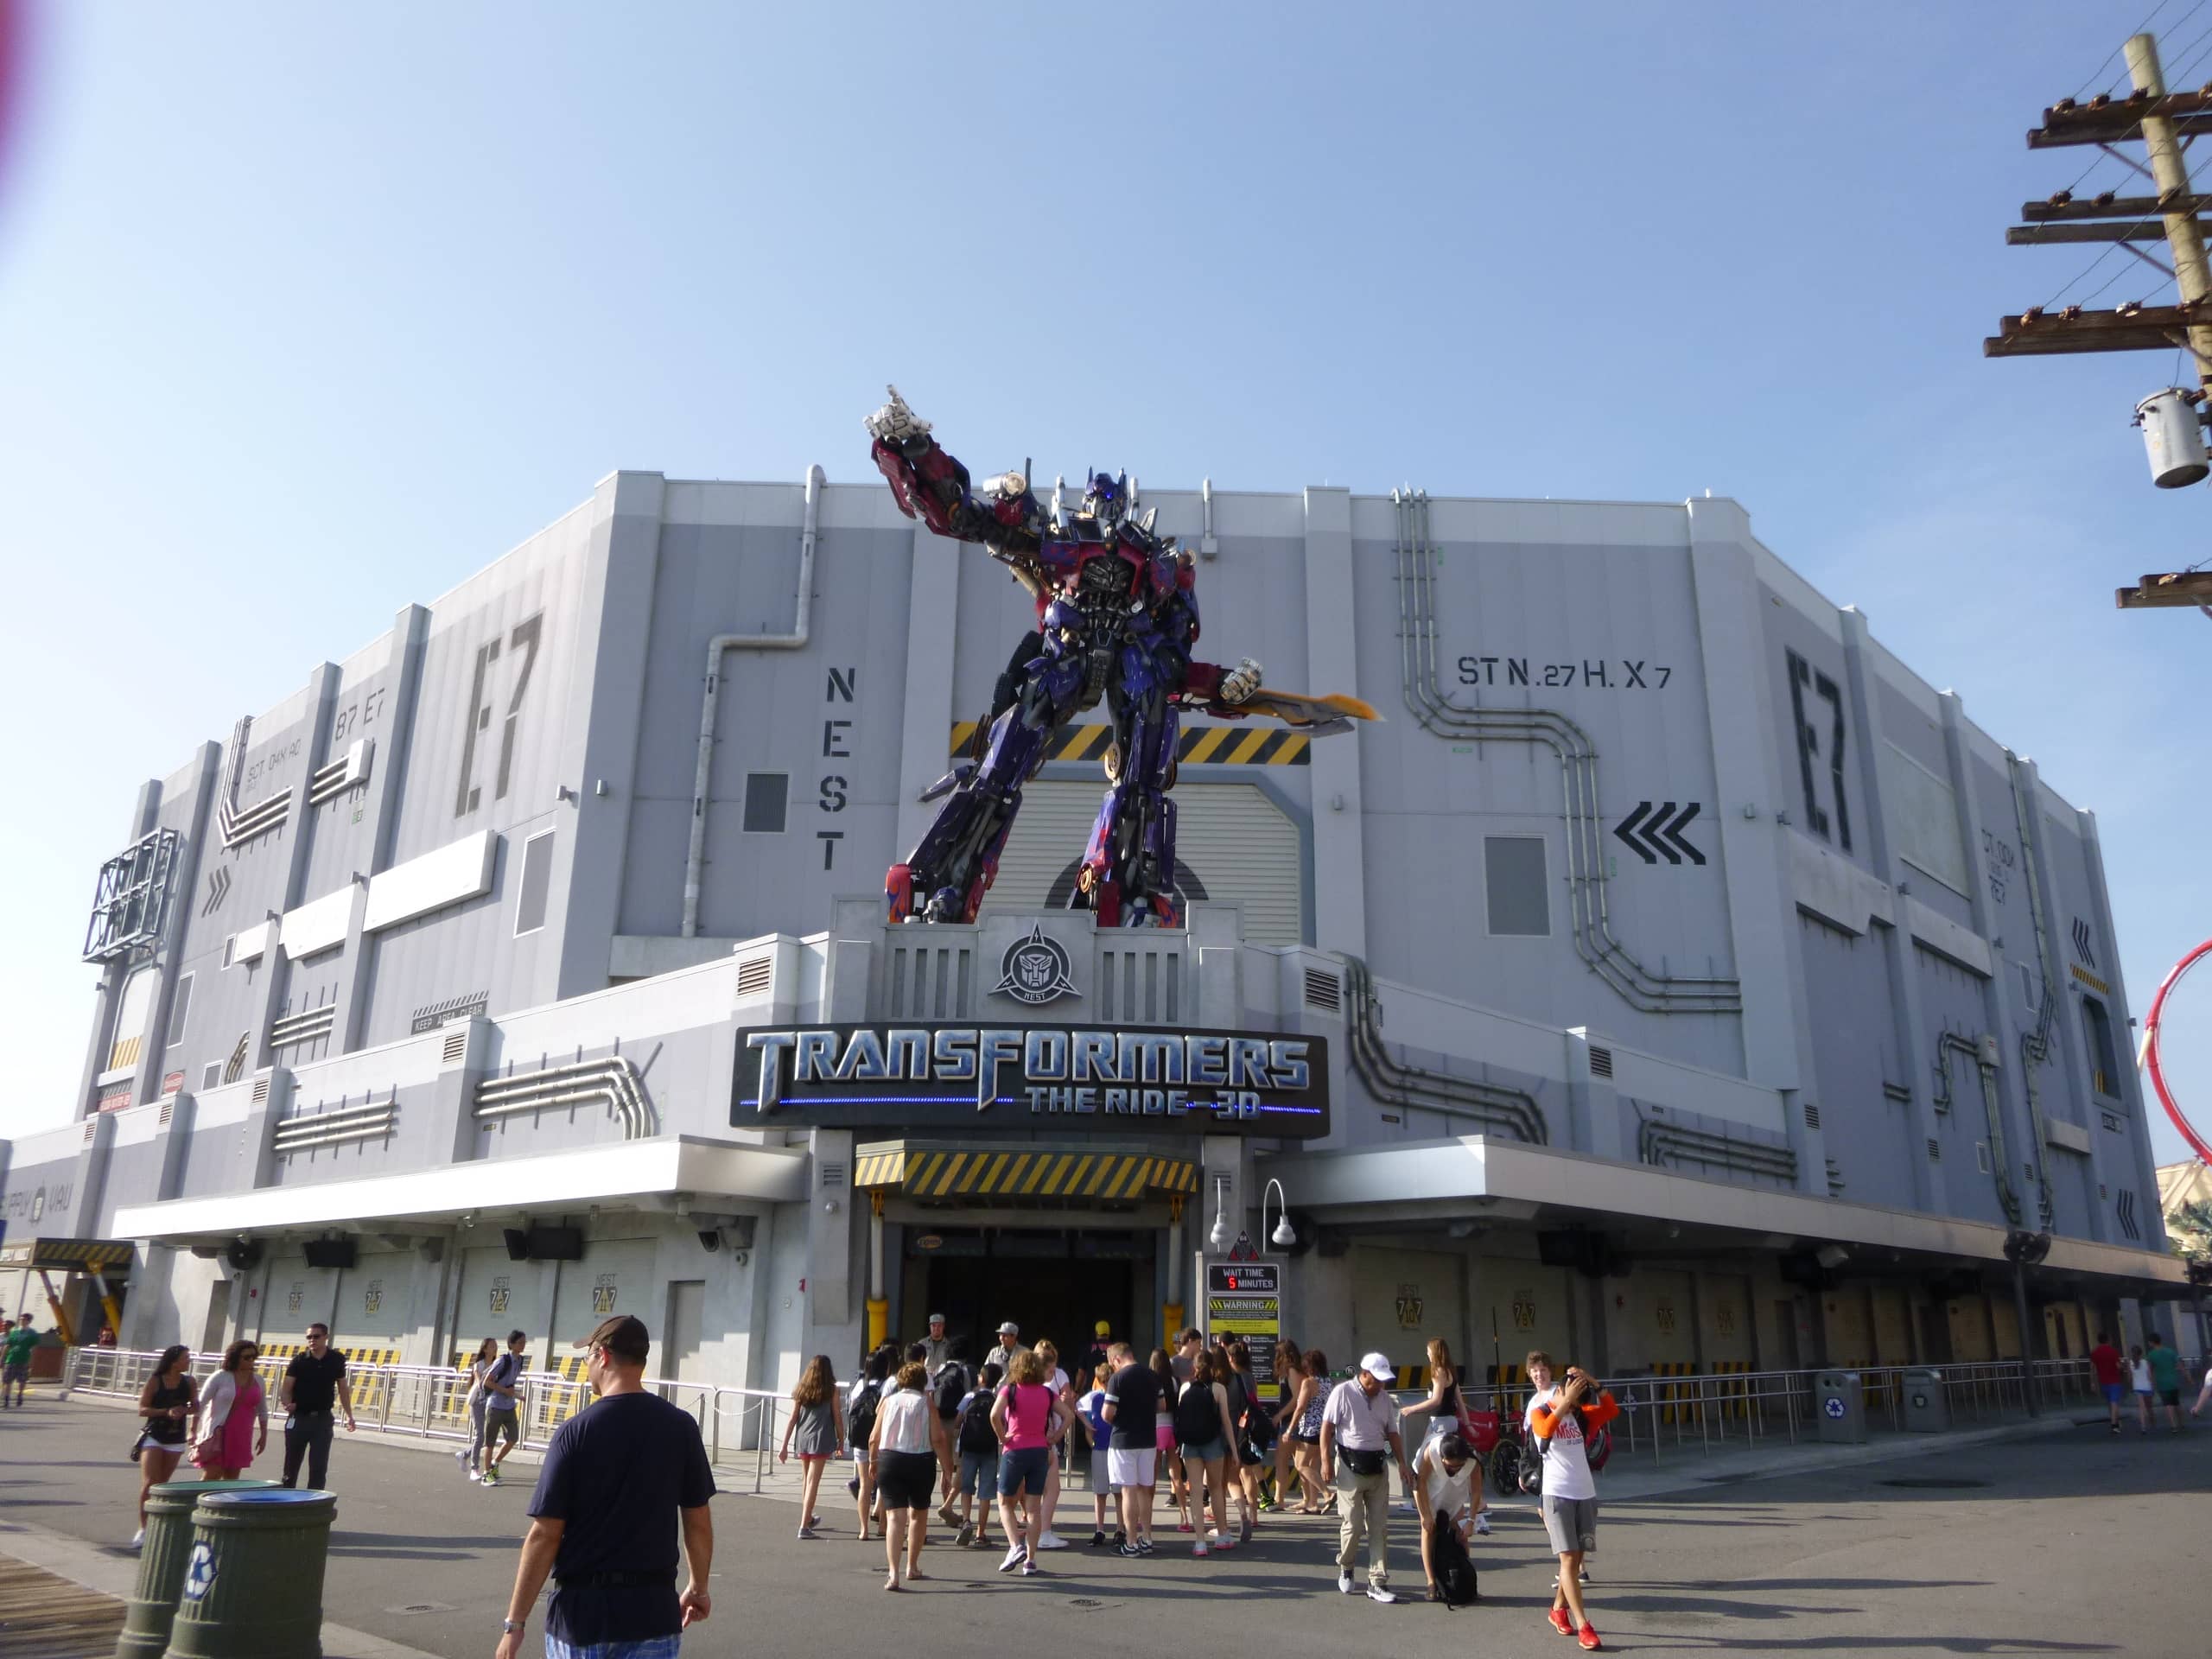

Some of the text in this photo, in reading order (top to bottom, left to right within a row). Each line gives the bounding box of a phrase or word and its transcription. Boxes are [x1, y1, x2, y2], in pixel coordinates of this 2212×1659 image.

[454, 613, 543, 819] E7
[1785, 645, 1853, 856] E7
[817, 667, 855, 871] NEST
[1023, 992, 1046, 1001] NEST
[414, 1018, 432, 1032] KEEP
[747, 1028, 1311, 1112] TRANSFORMERS
[1025, 1086, 1097, 1114] THE
[1105, 1088, 1189, 1116] RIDE
[1216, 1090, 1262, 1121] 3D
[1223, 1268, 1264, 1278] WAIT TIME
[1229, 1277, 1274, 1289] 5 MINUTES
[1223, 1300, 1265, 1310] WARNING
